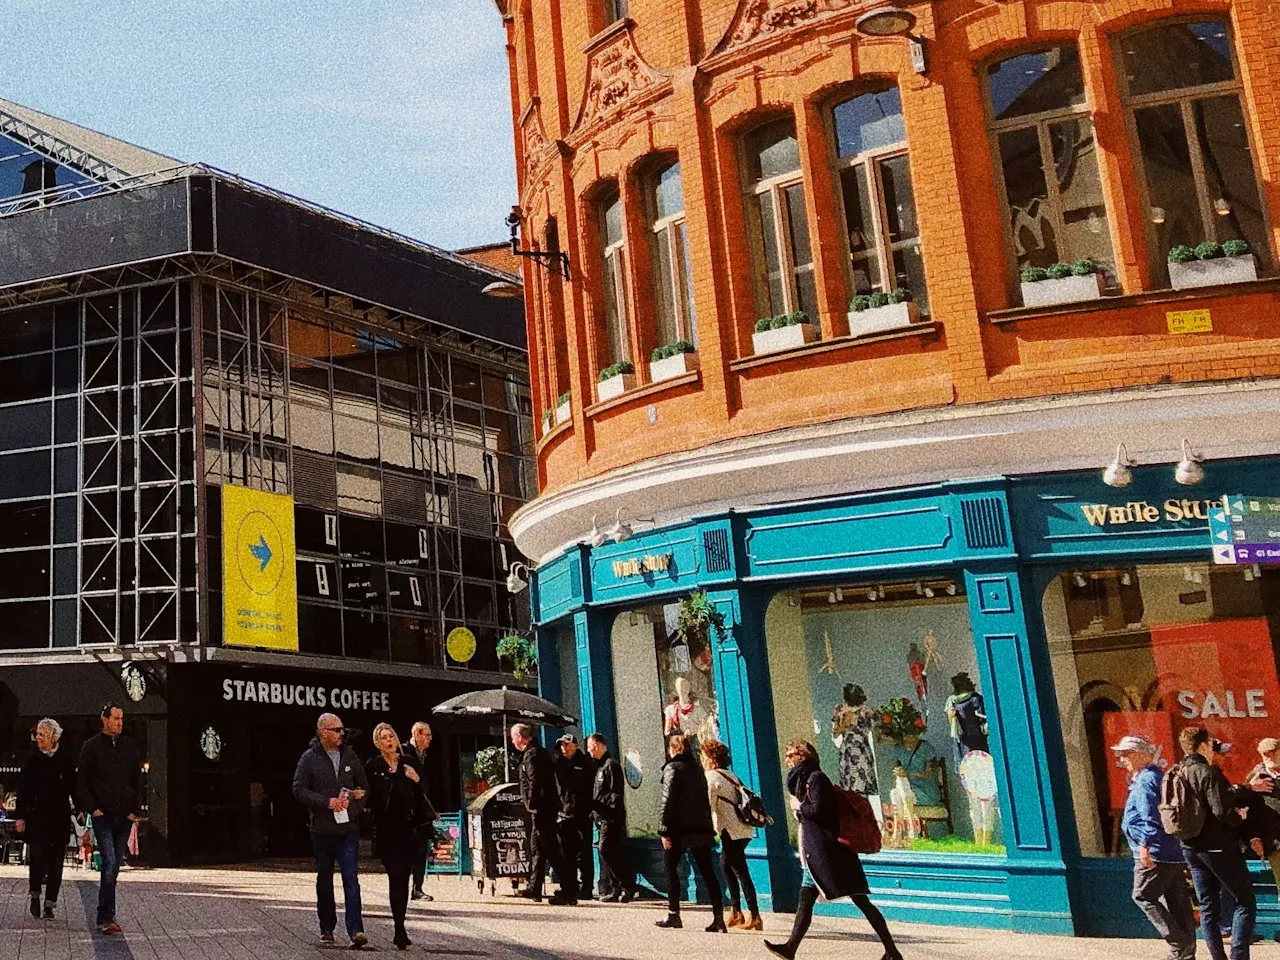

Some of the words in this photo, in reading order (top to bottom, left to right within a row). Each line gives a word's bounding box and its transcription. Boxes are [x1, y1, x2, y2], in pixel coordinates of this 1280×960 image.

[222, 678, 327, 708] STARBUCKS
[330, 688, 391, 712] COFFEE
[1177, 689, 1269, 719] SALE
[495, 861, 530, 875] TODAY
